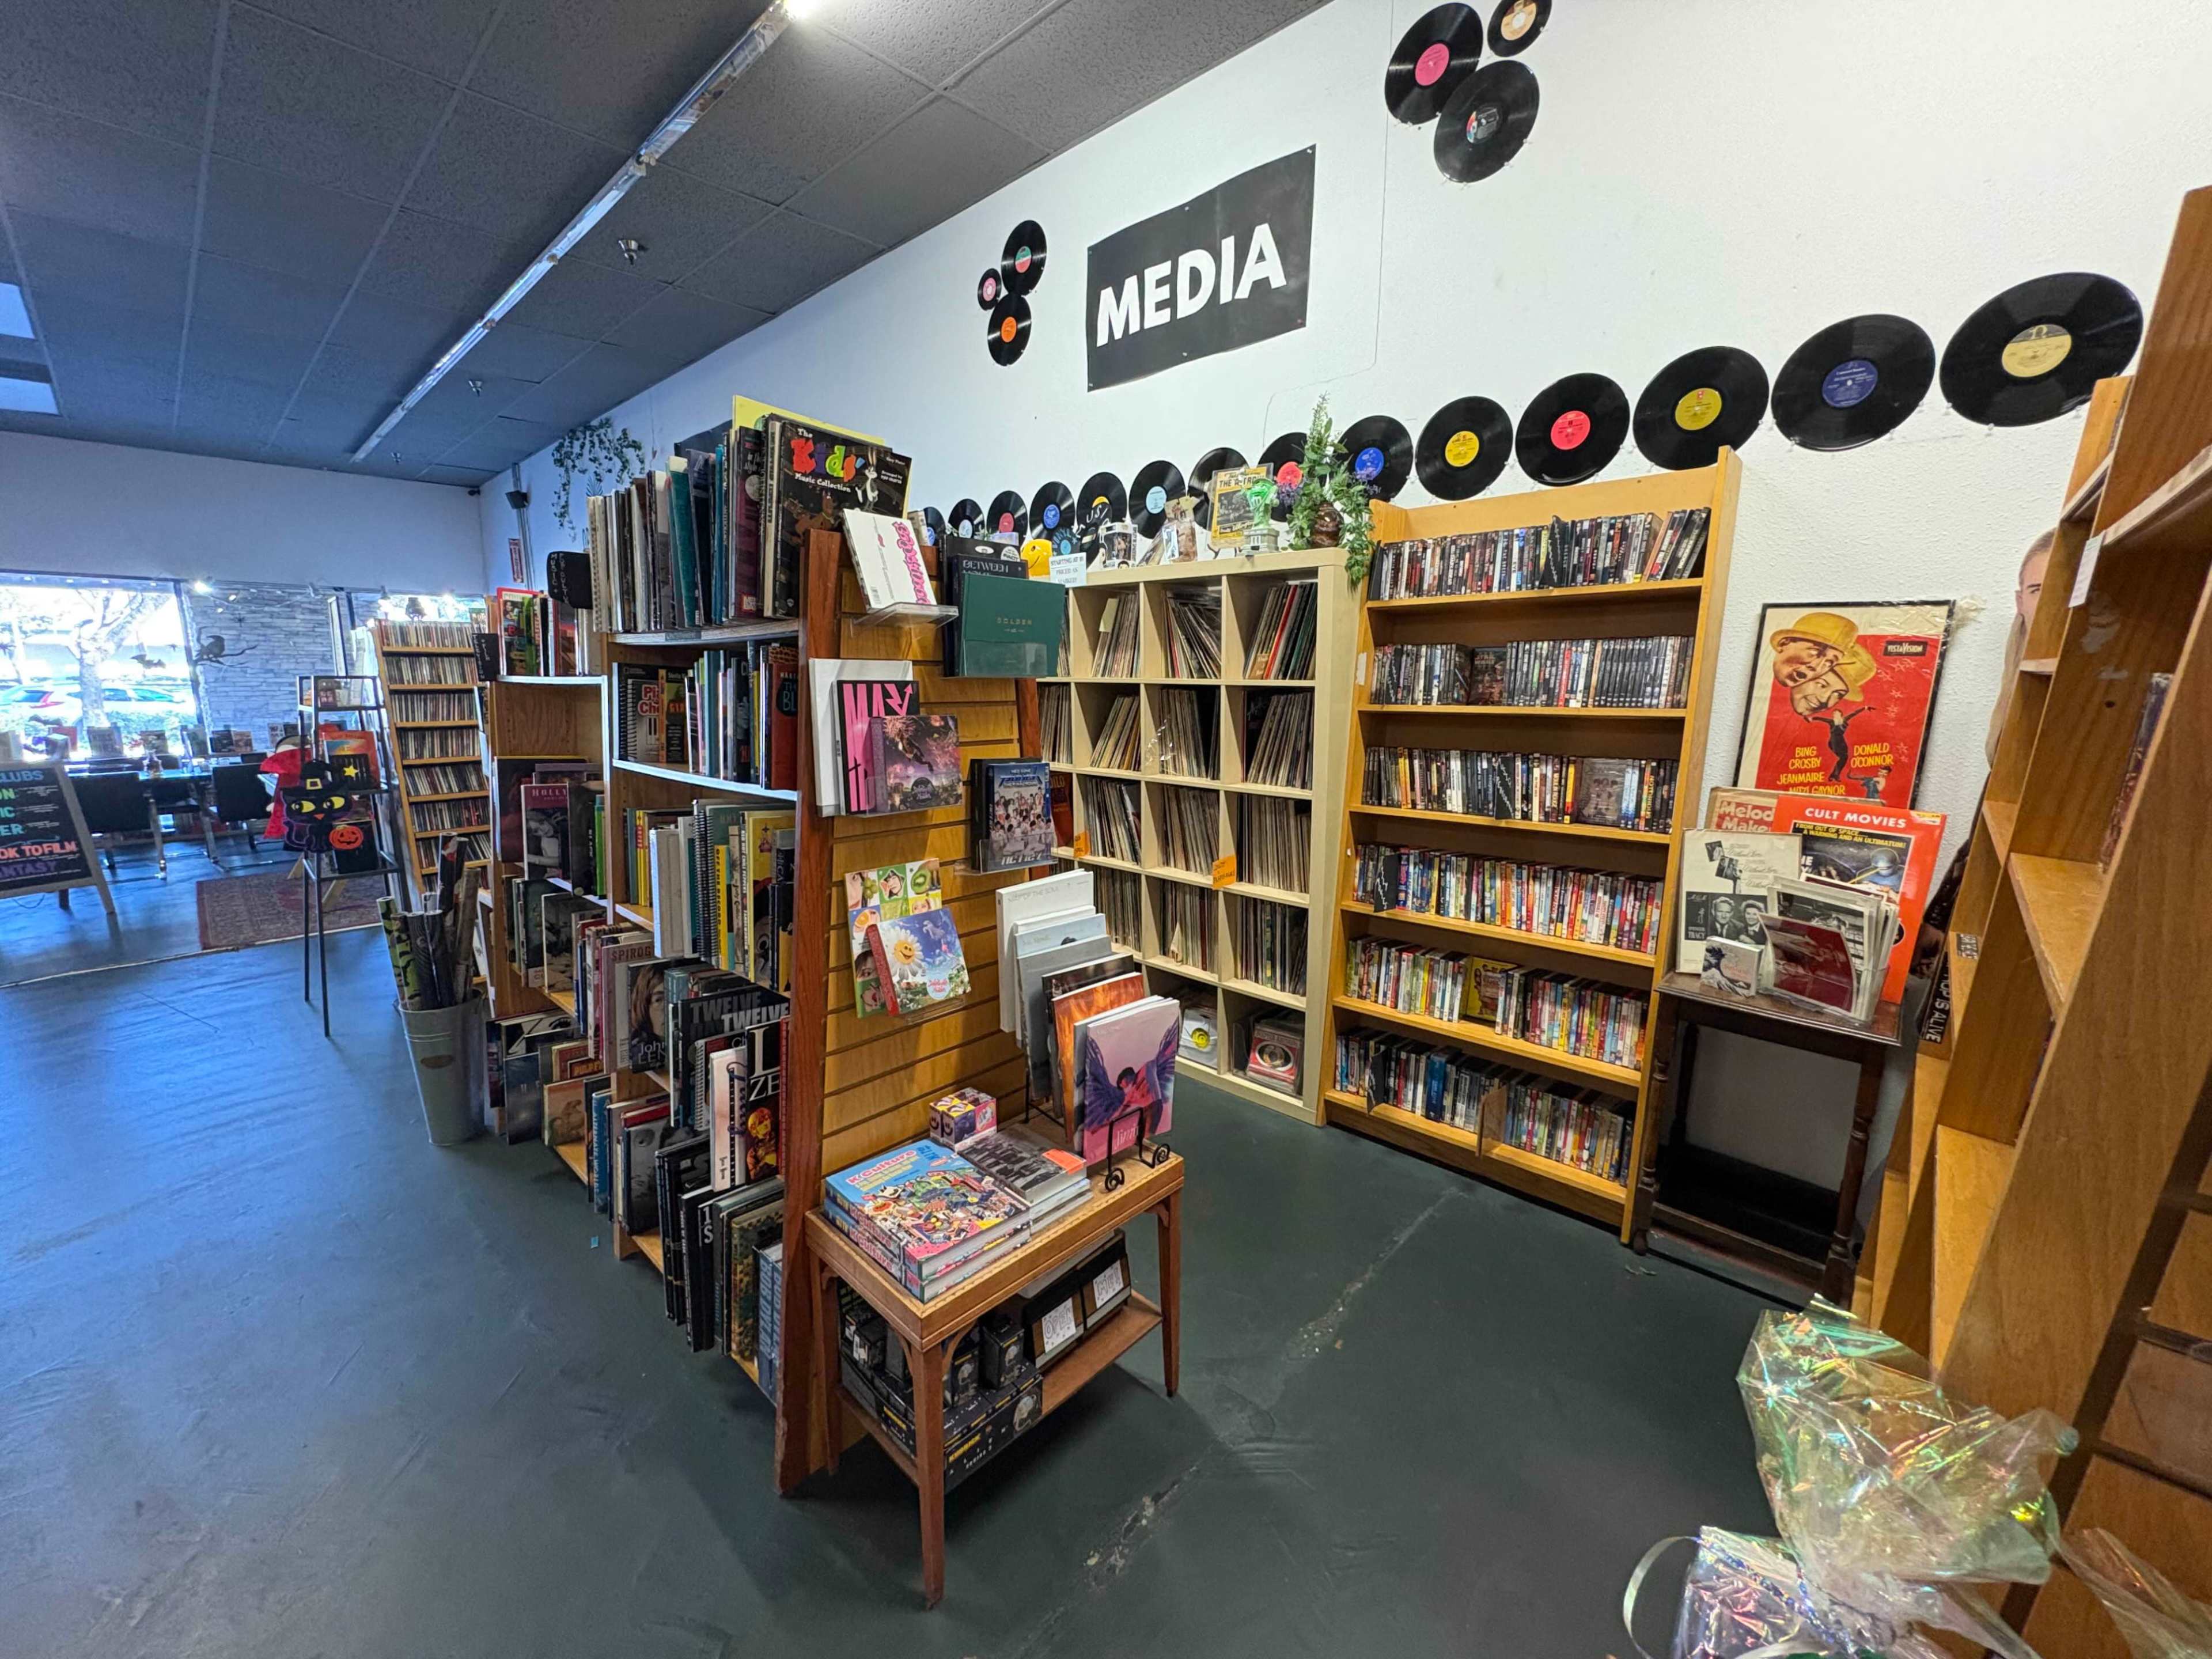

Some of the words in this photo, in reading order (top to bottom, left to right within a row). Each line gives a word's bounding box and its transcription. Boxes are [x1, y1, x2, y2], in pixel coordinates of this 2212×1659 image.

[1096, 223, 1286, 347] MEDIA
[797, 427, 813, 438] The
[795, 473, 815, 484] Music
[816, 479, 851, 493] Collection
[1795, 745, 1817, 758] BING
[1854, 743, 1890, 756] DONALD
[1789, 757, 1821, 770] CROSBY
[1850, 754, 1895, 768] O'CONNOR
[1777, 771, 1825, 785] JEANMAIRE
[1812, 784, 1846, 796] GAYNOR
[1805, 807, 1840, 820] CULT
[1844, 812, 1907, 828] MOVIES
[1808, 831, 1839, 839] WARNING
[1839, 834, 1853, 842] AND
[1864, 837, 1906, 849] ULTIMATUM!
[21, 844, 41, 857] TO
[43, 841, 77, 854] FILM
[1688, 930, 1706, 940] TRACY
[1926, 1010, 1947, 1044] ALIVE
[846, 1173, 861, 1185] K
[759, 1256, 772, 1297] BOB
[759, 1297, 772, 1359] DYLAN
[1044, 1308, 1072, 1340] OPEN
